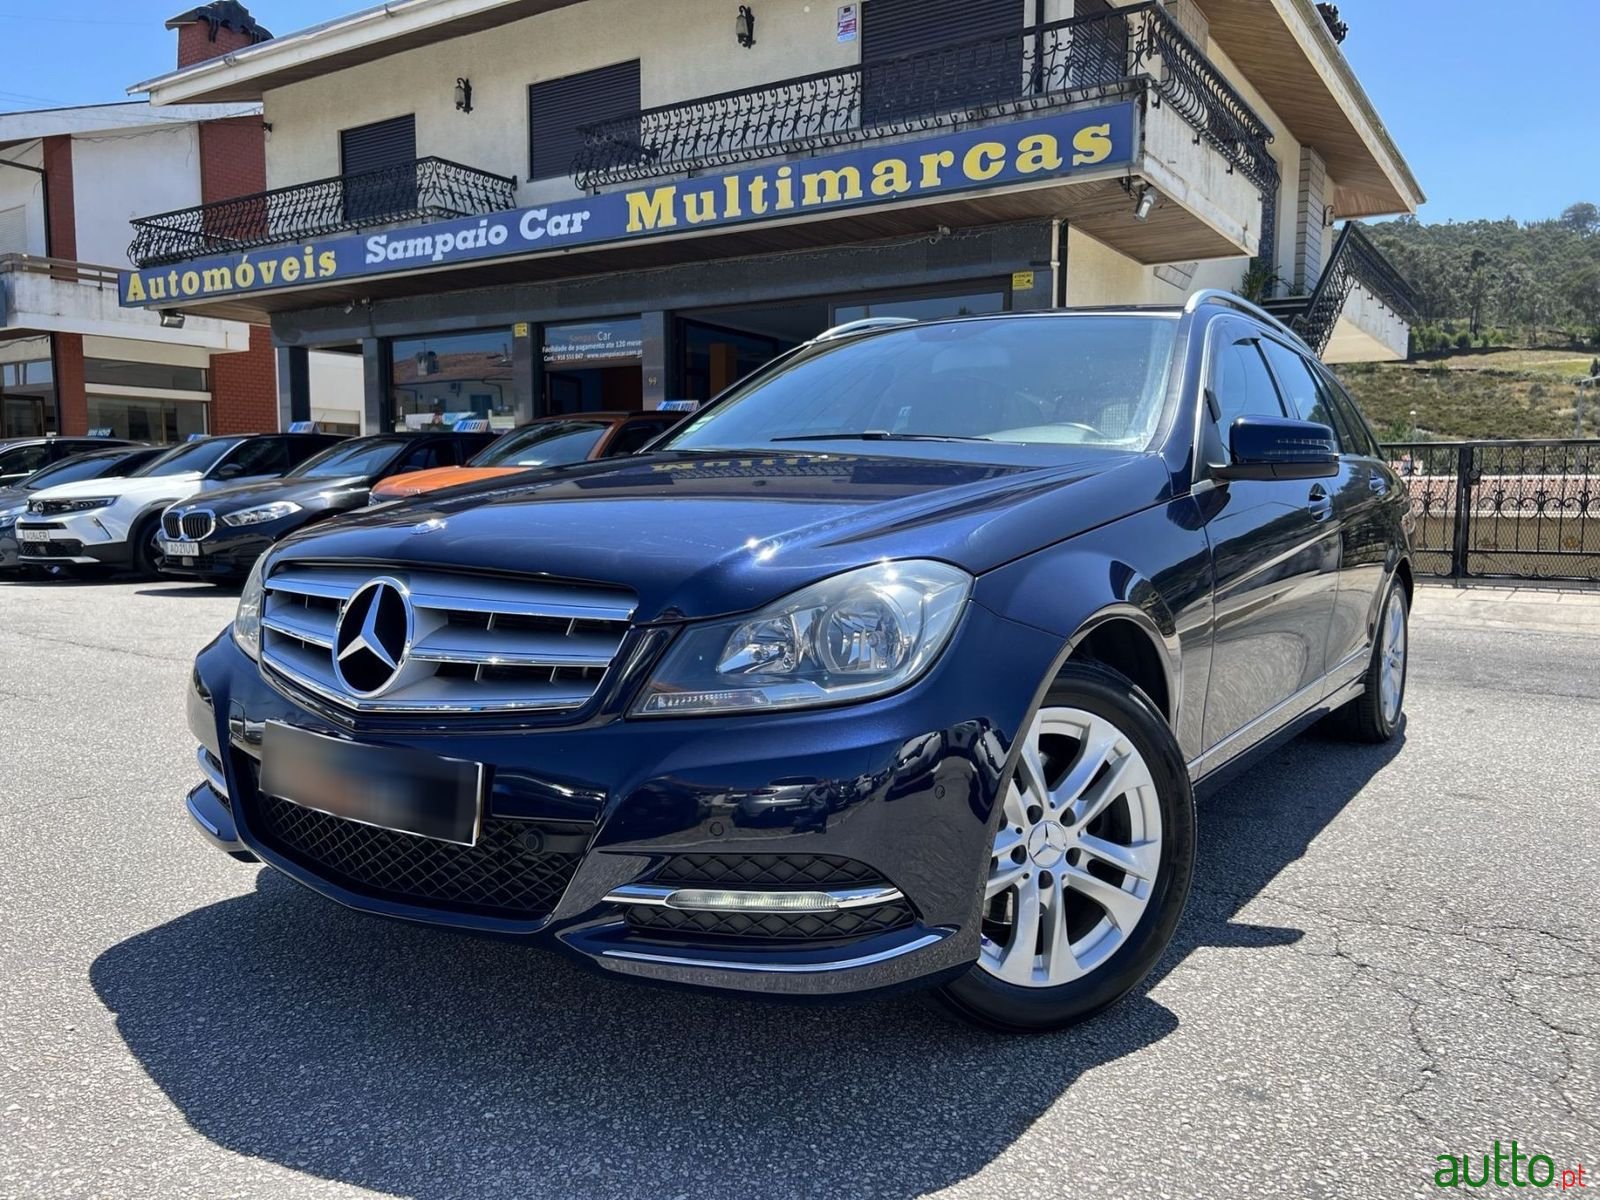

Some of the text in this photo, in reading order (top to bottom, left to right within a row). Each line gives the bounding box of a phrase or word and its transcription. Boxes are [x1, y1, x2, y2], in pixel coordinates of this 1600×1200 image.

[126, 123, 1113, 302] Automóveis Sampaio Car Multimarcas
[575, 342, 605, 352] pagamento
[616, 340, 626, 348] 120
